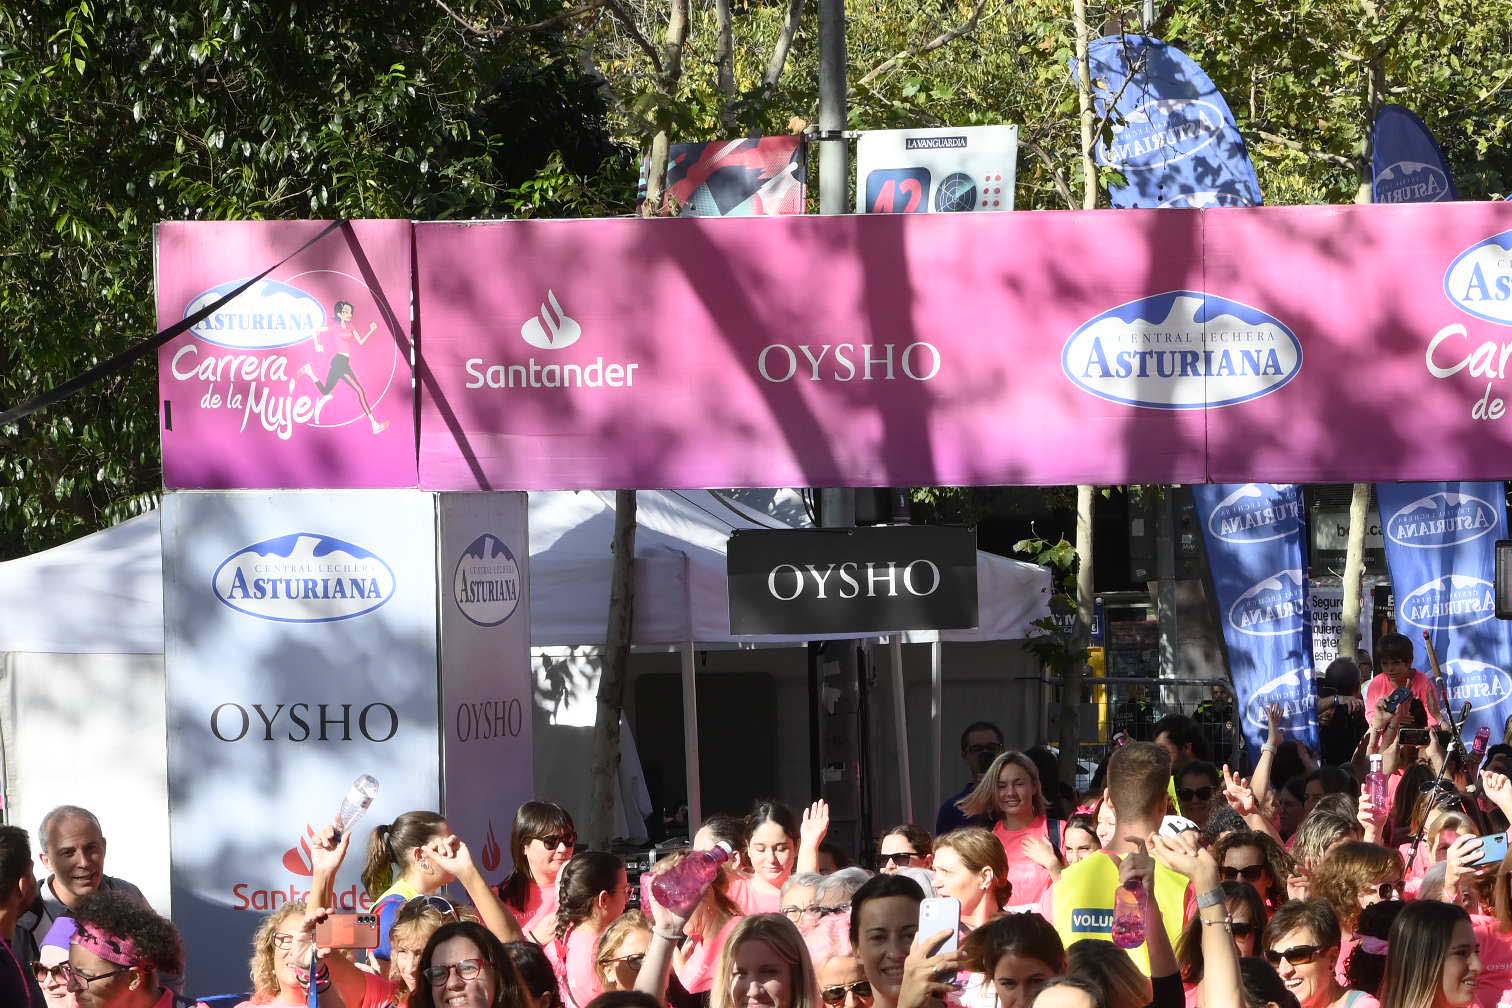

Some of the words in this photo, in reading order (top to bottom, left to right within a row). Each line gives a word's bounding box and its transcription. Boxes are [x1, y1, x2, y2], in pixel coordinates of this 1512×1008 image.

[907, 138, 917, 149] LA
[917, 136, 967, 149] VANGUARDIA
[195, 304, 315, 331] ASTURIANA
[1117, 332, 1193, 344] CENTRAL
[1200, 330, 1275, 343] LECHERA
[171, 343, 289, 383] Carrera
[465, 357, 639, 389] Santander
[758, 341, 941, 382] OYSHO
[1082, 336, 1284, 379] ASTURIANA
[200, 383, 221, 410] de
[227, 383, 243, 410] la
[241, 381, 332, 441] Mujer
[1472, 382, 1505, 421] de
[227, 567, 382, 600] ASTURIANA
[460, 569, 517, 602] ASTURIANA
[768, 559, 940, 600] OYSHO
[1313, 612, 1329, 621] que
[1313, 623, 1343, 635] quiere
[1315, 652, 1332, 661] este
[210, 702, 399, 742] OYSHO
[456, 699, 523, 742] OYSHO
